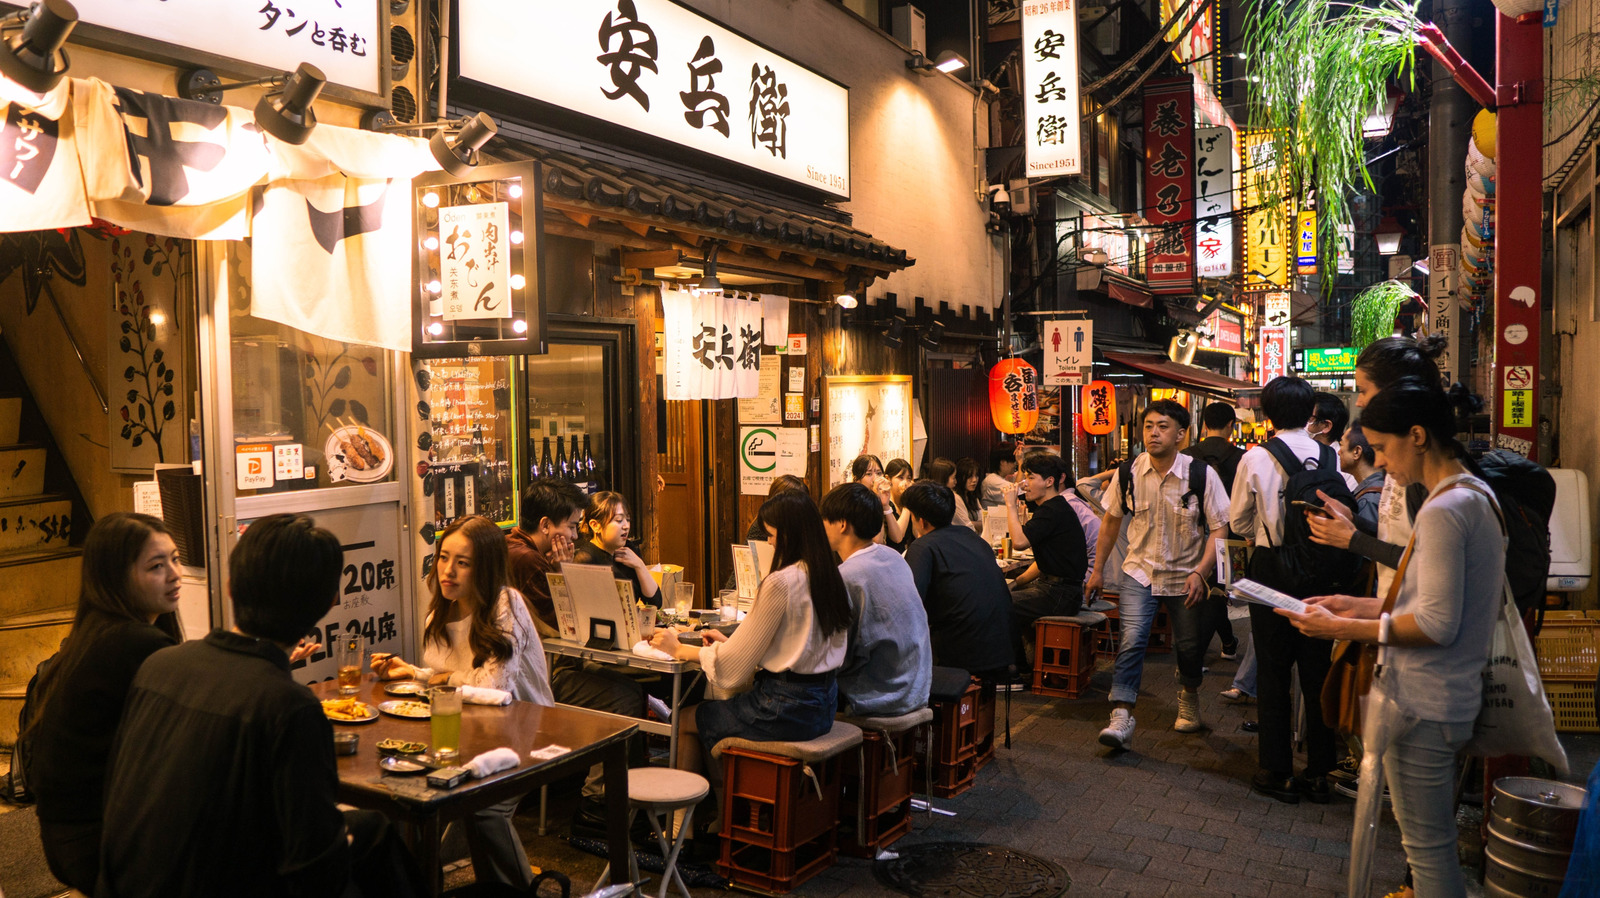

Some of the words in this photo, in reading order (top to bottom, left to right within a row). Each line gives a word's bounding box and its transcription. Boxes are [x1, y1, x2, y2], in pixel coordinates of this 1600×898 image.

[1025, 0, 1070, 16] 昭和26年創業
[259, 2, 367, 57] タンと呑む
[597, 0, 791, 160] 安兵衛
[1033, 29, 1068, 147] 安兵衛
[806, 163, 828, 185] Since
[828, 174, 847, 191] 1951
[1029, 158, 1076, 171] Since1951
[443, 212, 466, 222] Oden
[482, 222, 499, 273] 肉出汁
[1302, 231, 1313, 252] 松屋
[445, 224, 502, 312] おでん
[1154, 262, 1185, 273] 加盟店
[1436, 251, 1453, 269] 質
[692, 322, 761, 371] 安兵衛
[1056, 356, 1080, 364] トイレ
[1020, 367, 1037, 411] 旨い酒
[1511, 390, 1525, 424] 路上喫煙禁止
[244, 475, 266, 484] PayPay
[343, 559, 395, 595] 20席
[344, 594, 373, 610] お座敷
